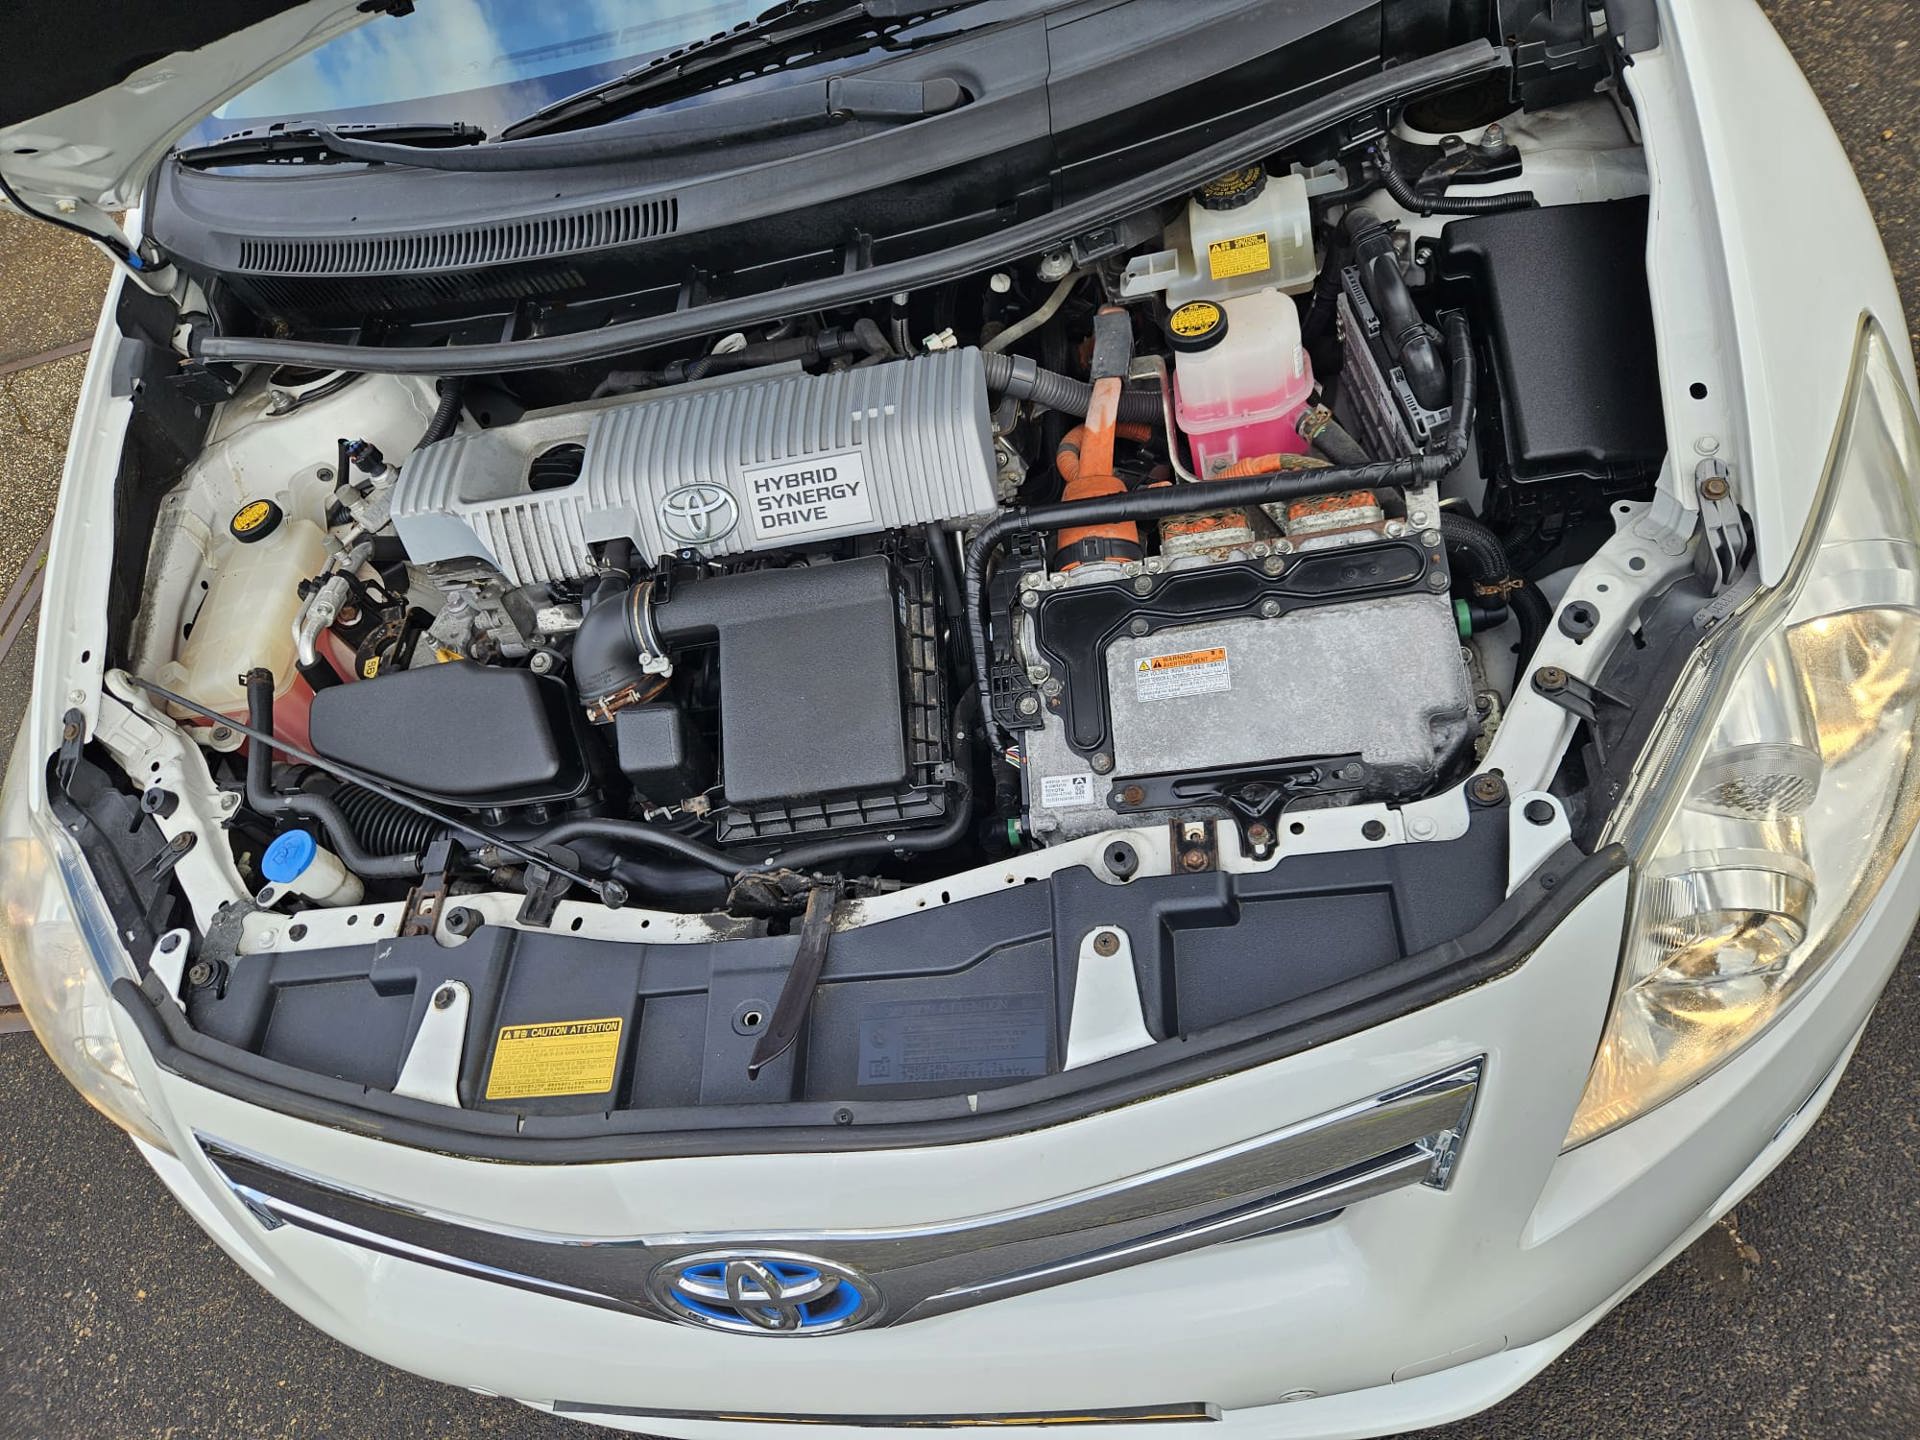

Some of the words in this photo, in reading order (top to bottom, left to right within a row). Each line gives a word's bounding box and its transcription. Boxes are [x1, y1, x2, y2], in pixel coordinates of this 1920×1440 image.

[754, 467, 837, 494] HYBRID
[757, 481, 860, 512] SYNERGY
[761, 506, 828, 529] DRIVE
[1162, 653, 1193, 662] WARNING
[531, 1026, 568, 1037] CAUTION
[570, 1022, 618, 1034] ATTENTION
